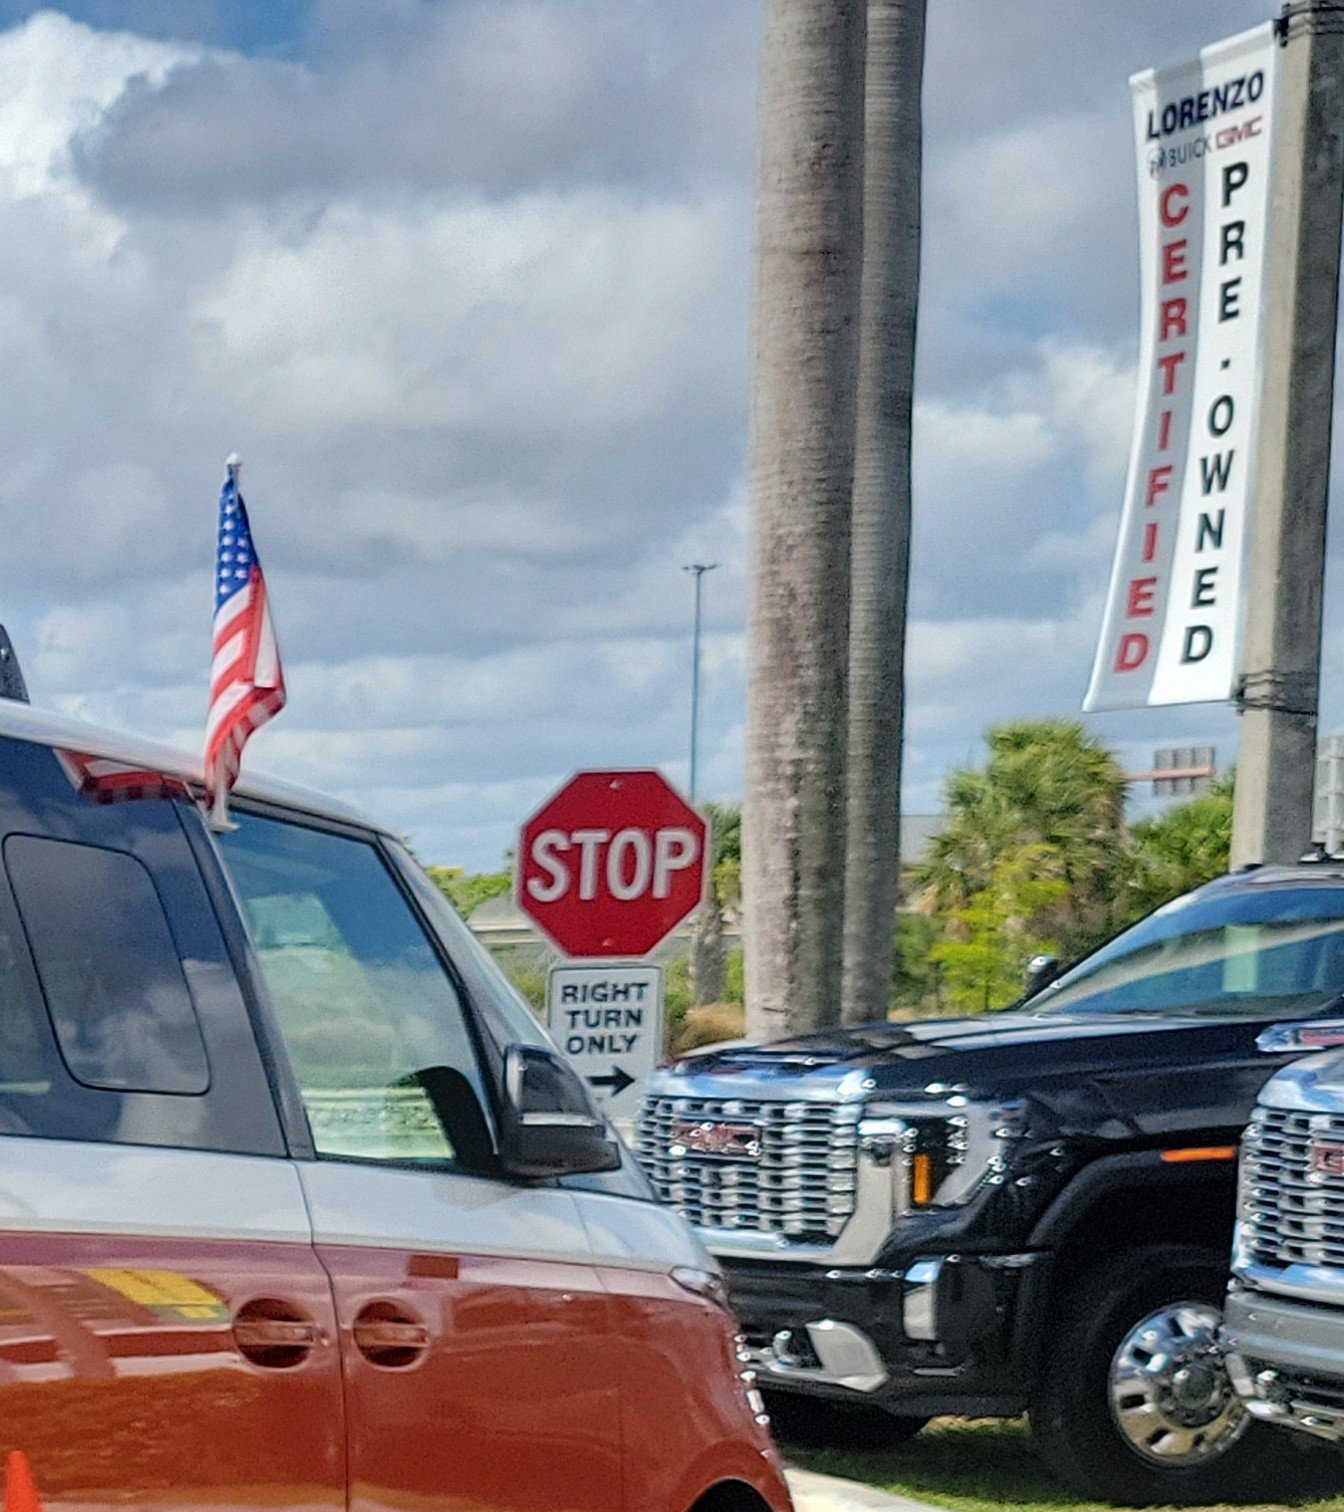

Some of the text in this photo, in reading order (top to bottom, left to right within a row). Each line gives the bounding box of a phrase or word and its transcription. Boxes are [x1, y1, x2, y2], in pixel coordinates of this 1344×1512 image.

[1146, 68, 1265, 140] LORENZO
[1168, 116, 1263, 168] BUICK GMC
[1115, 183, 1190, 674] CERTIFIED
[526, 828, 698, 902] STOP
[561, 982, 649, 1003] RIGHT
[565, 1008, 643, 1028] TURN
[565, 1034, 638, 1055] ONLY
